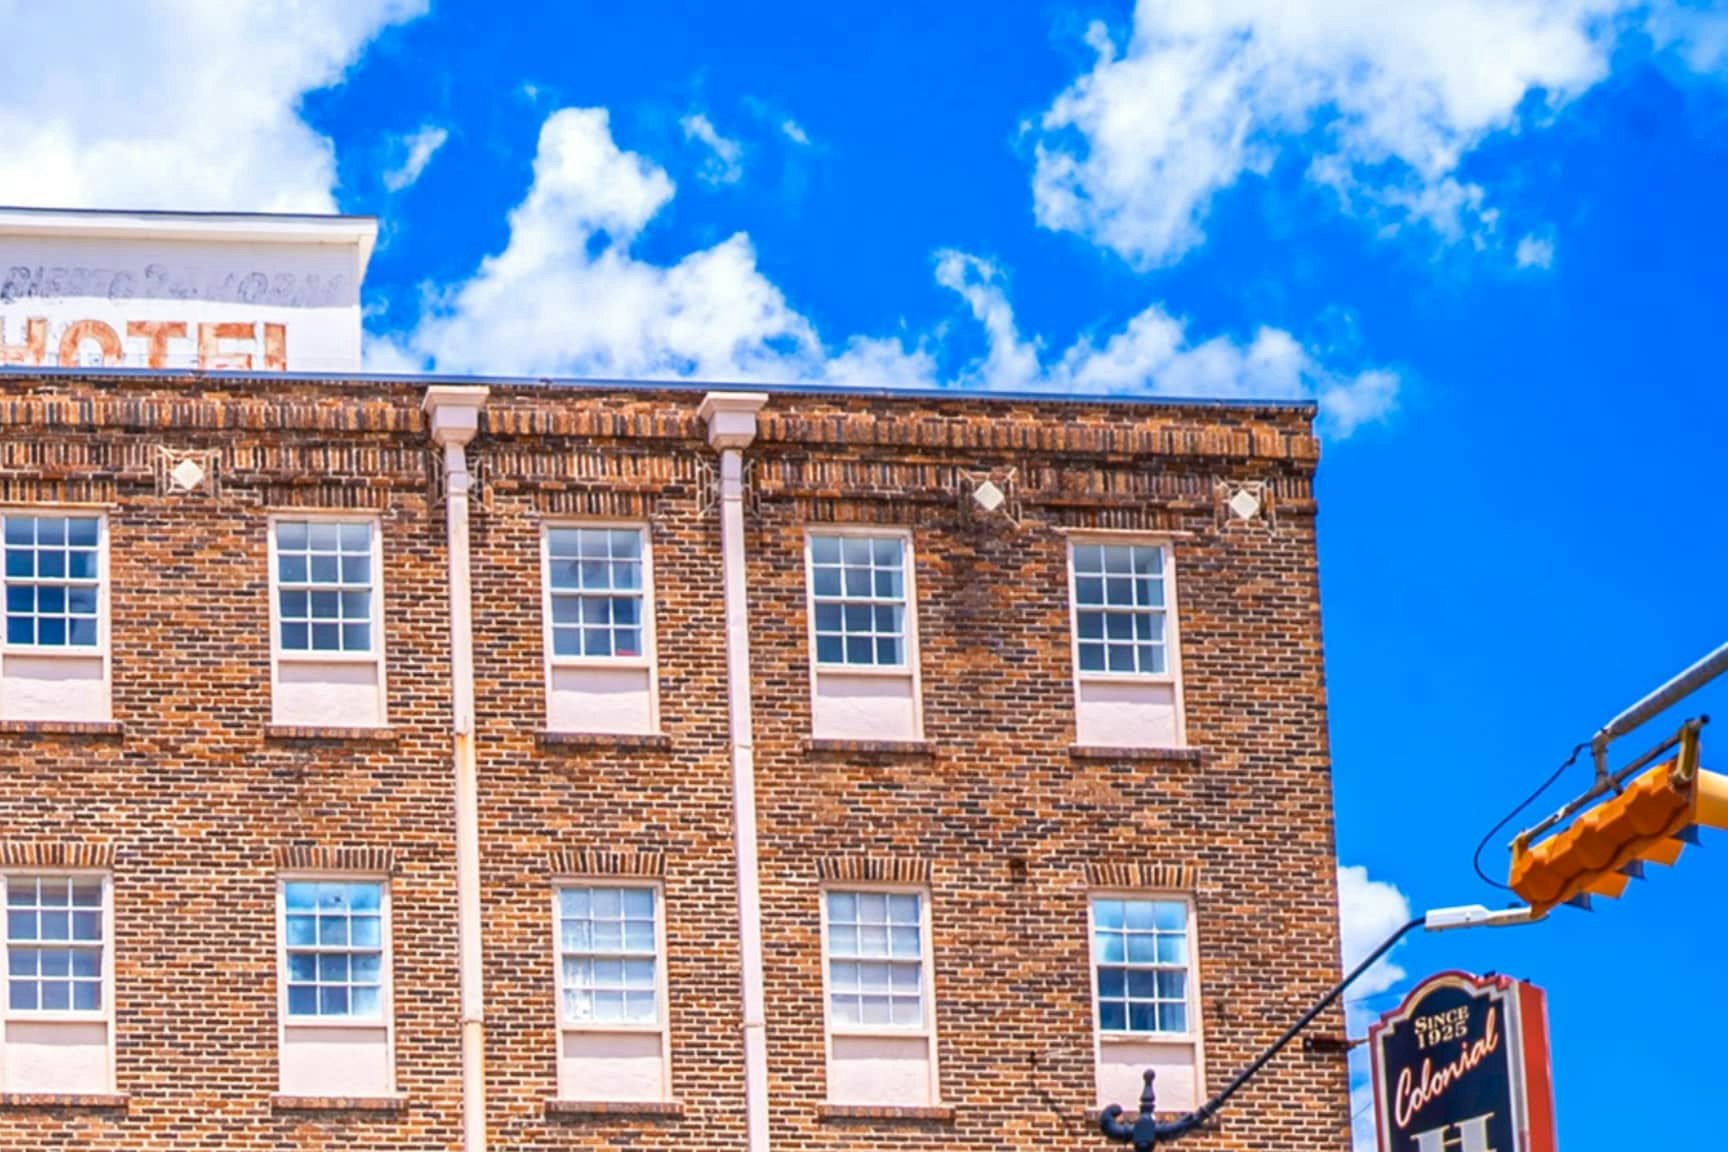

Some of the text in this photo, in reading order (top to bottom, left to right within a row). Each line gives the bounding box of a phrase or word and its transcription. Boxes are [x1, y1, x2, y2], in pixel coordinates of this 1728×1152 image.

[1414, 1005, 1470, 1035] SINCE
[1417, 1020, 1469, 1049] 1925
[1394, 1006, 1500, 1129] Colonial
